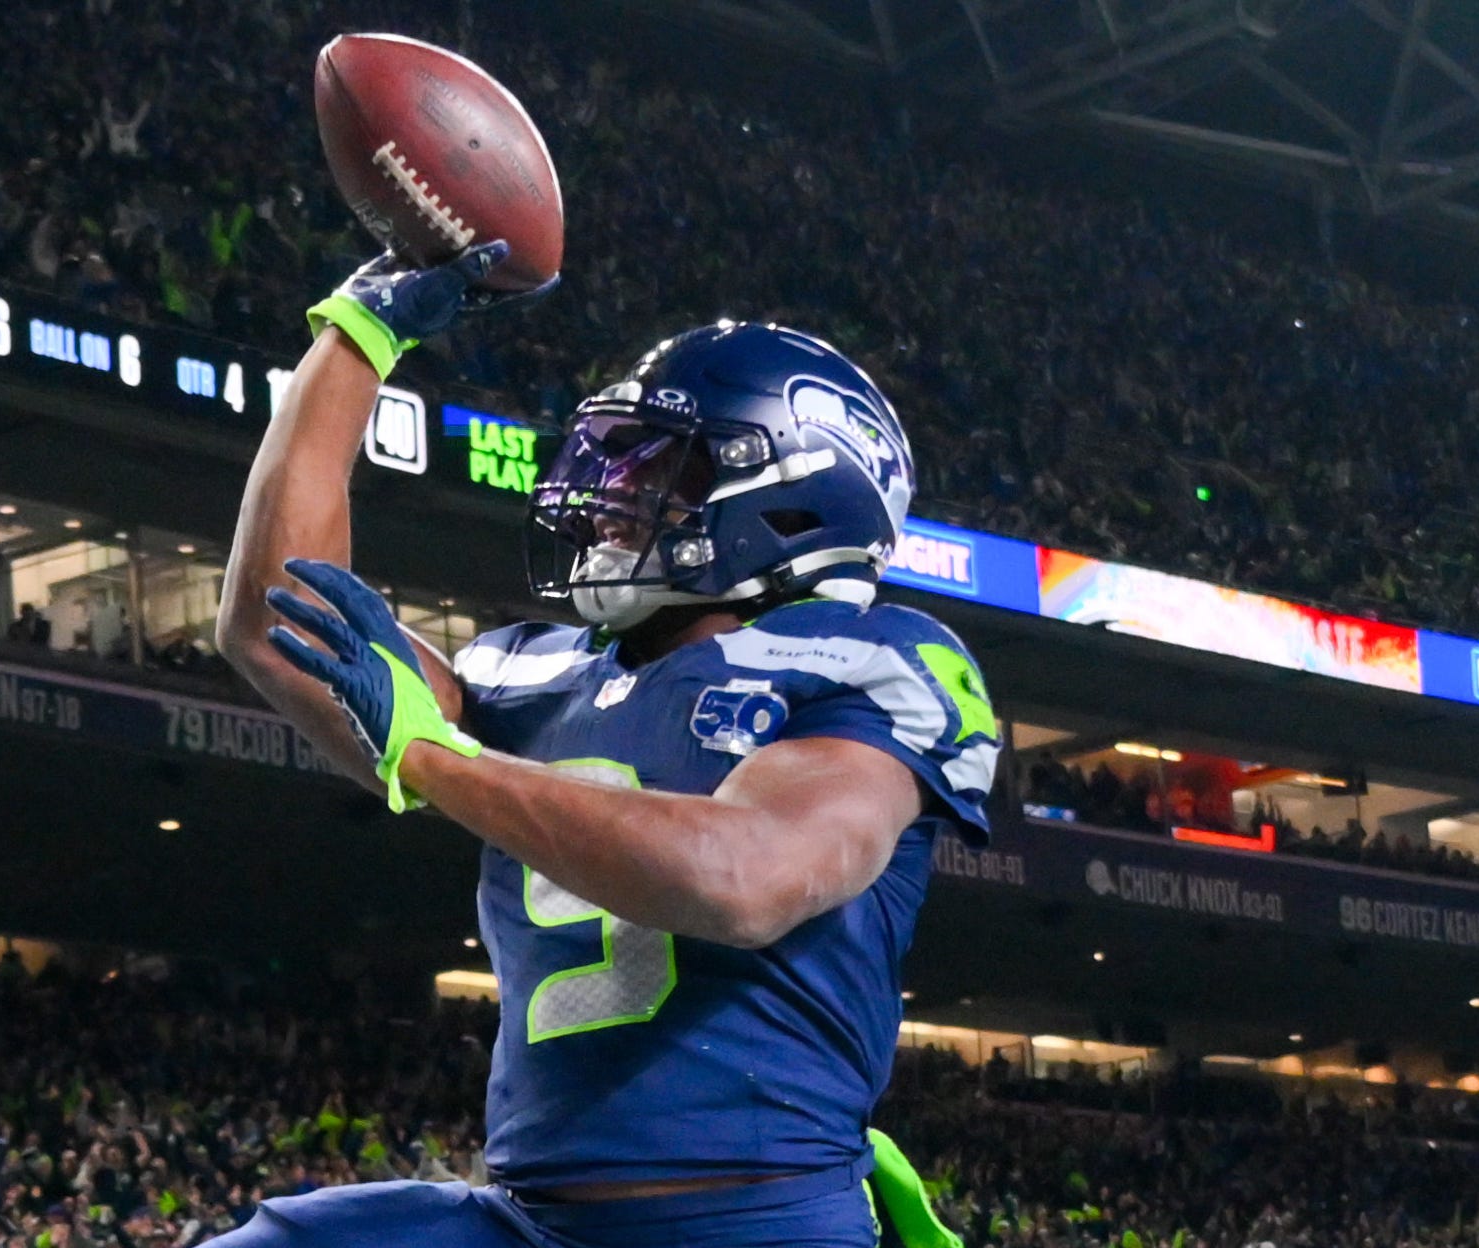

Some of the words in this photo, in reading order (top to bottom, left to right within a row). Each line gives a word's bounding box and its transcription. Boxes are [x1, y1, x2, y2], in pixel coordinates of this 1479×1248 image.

[30, 318, 78, 364] BALL
[79, 331, 111, 371] ON
[119, 334, 141, 387] 6
[177, 357, 215, 398] QTR
[223, 363, 244, 412] 4
[375, 399, 415, 459] 40
[469, 418, 536, 462] LAST
[469, 451, 537, 494] PLAY
[889, 532, 970, 583] IGHT
[163, 702, 206, 750] 79
[210, 712, 287, 767] JACOB
[1118, 864, 1183, 909] CHUCK
[1187, 876, 1240, 916] KNOX
[1339, 895, 1371, 933] 96
[1374, 901, 1442, 941] CORTEZ
